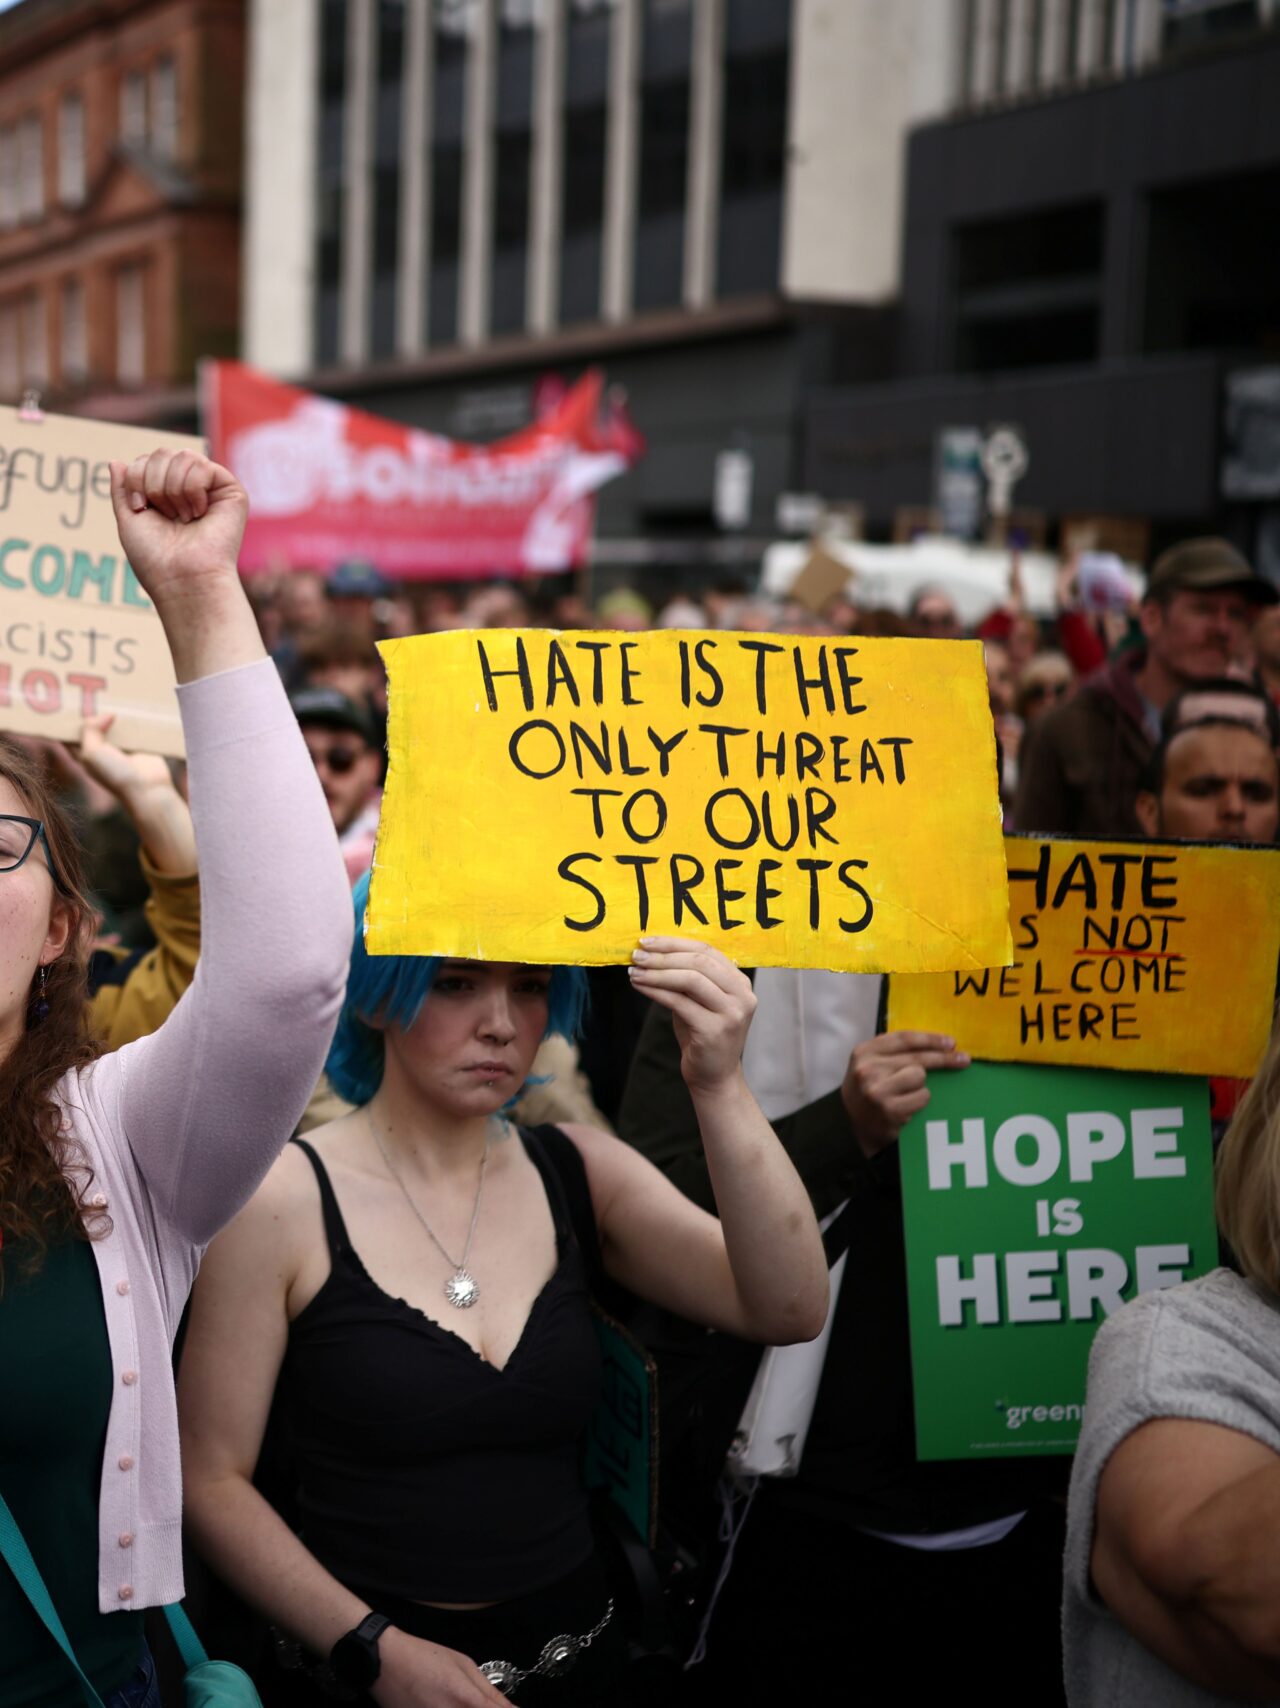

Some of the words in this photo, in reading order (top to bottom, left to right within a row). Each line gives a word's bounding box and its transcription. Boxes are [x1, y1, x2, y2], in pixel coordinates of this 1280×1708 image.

[477, 636, 643, 712] HATE
[680, 639, 723, 708] IS
[738, 640, 867, 718] THE
[509, 718, 688, 779] ONLY
[698, 723, 914, 784] THREAT
[570, 788, 668, 844] TO
[704, 786, 840, 851] OUR
[557, 852, 874, 933] STREETS
[1008, 844, 1177, 910] HATE
[1016, 914, 1039, 949] S
[1083, 915, 1186, 952] NOT
[954, 957, 1187, 997] WELCOME
[1021, 1002, 1141, 1045] HERE
[926, 1107, 1186, 1190] HOPE
[1036, 1197, 1084, 1237] IS
[936, 1244, 1189, 1326] HERE
[1006, 1404, 1087, 1429] green
